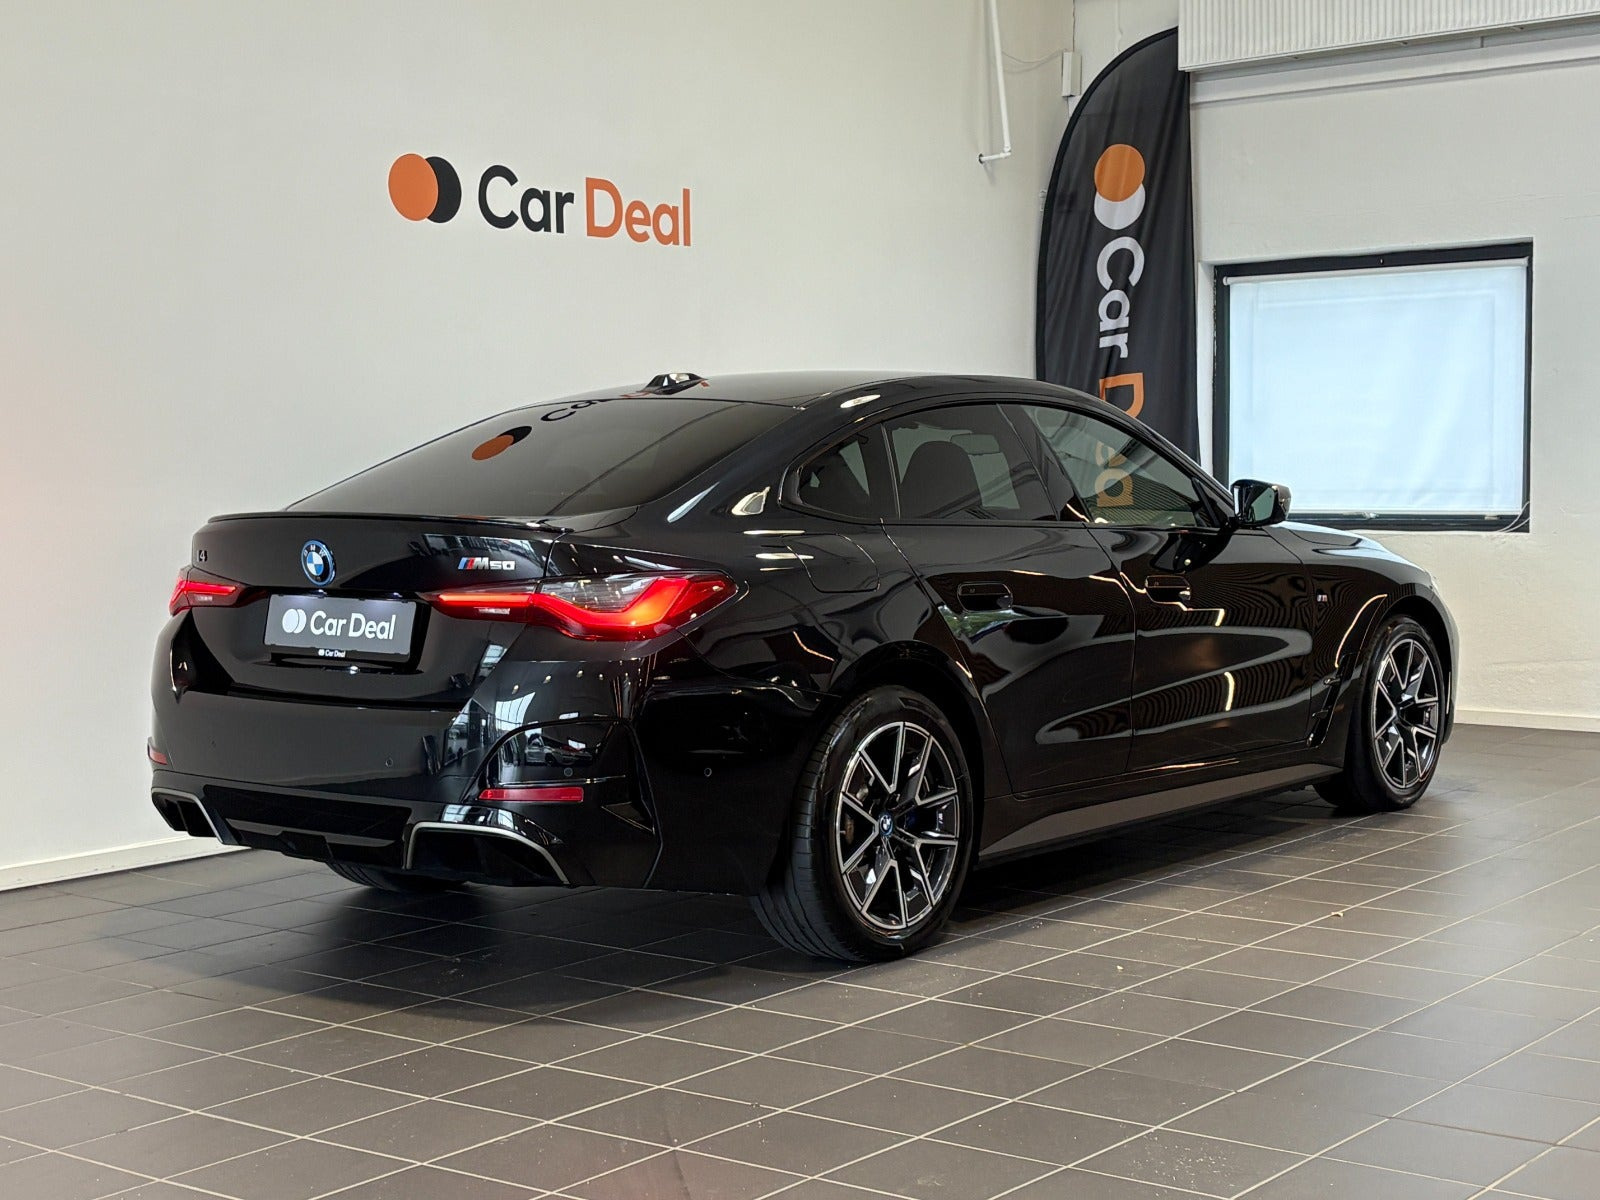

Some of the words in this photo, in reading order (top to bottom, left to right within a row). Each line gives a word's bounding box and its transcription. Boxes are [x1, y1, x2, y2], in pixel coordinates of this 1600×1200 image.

[478, 164, 575, 234] Car
[585, 177, 691, 247] Deal
[1096, 236, 1145, 359] Car
[310, 610, 347, 636] Car
[348, 612, 396, 640] Deal
